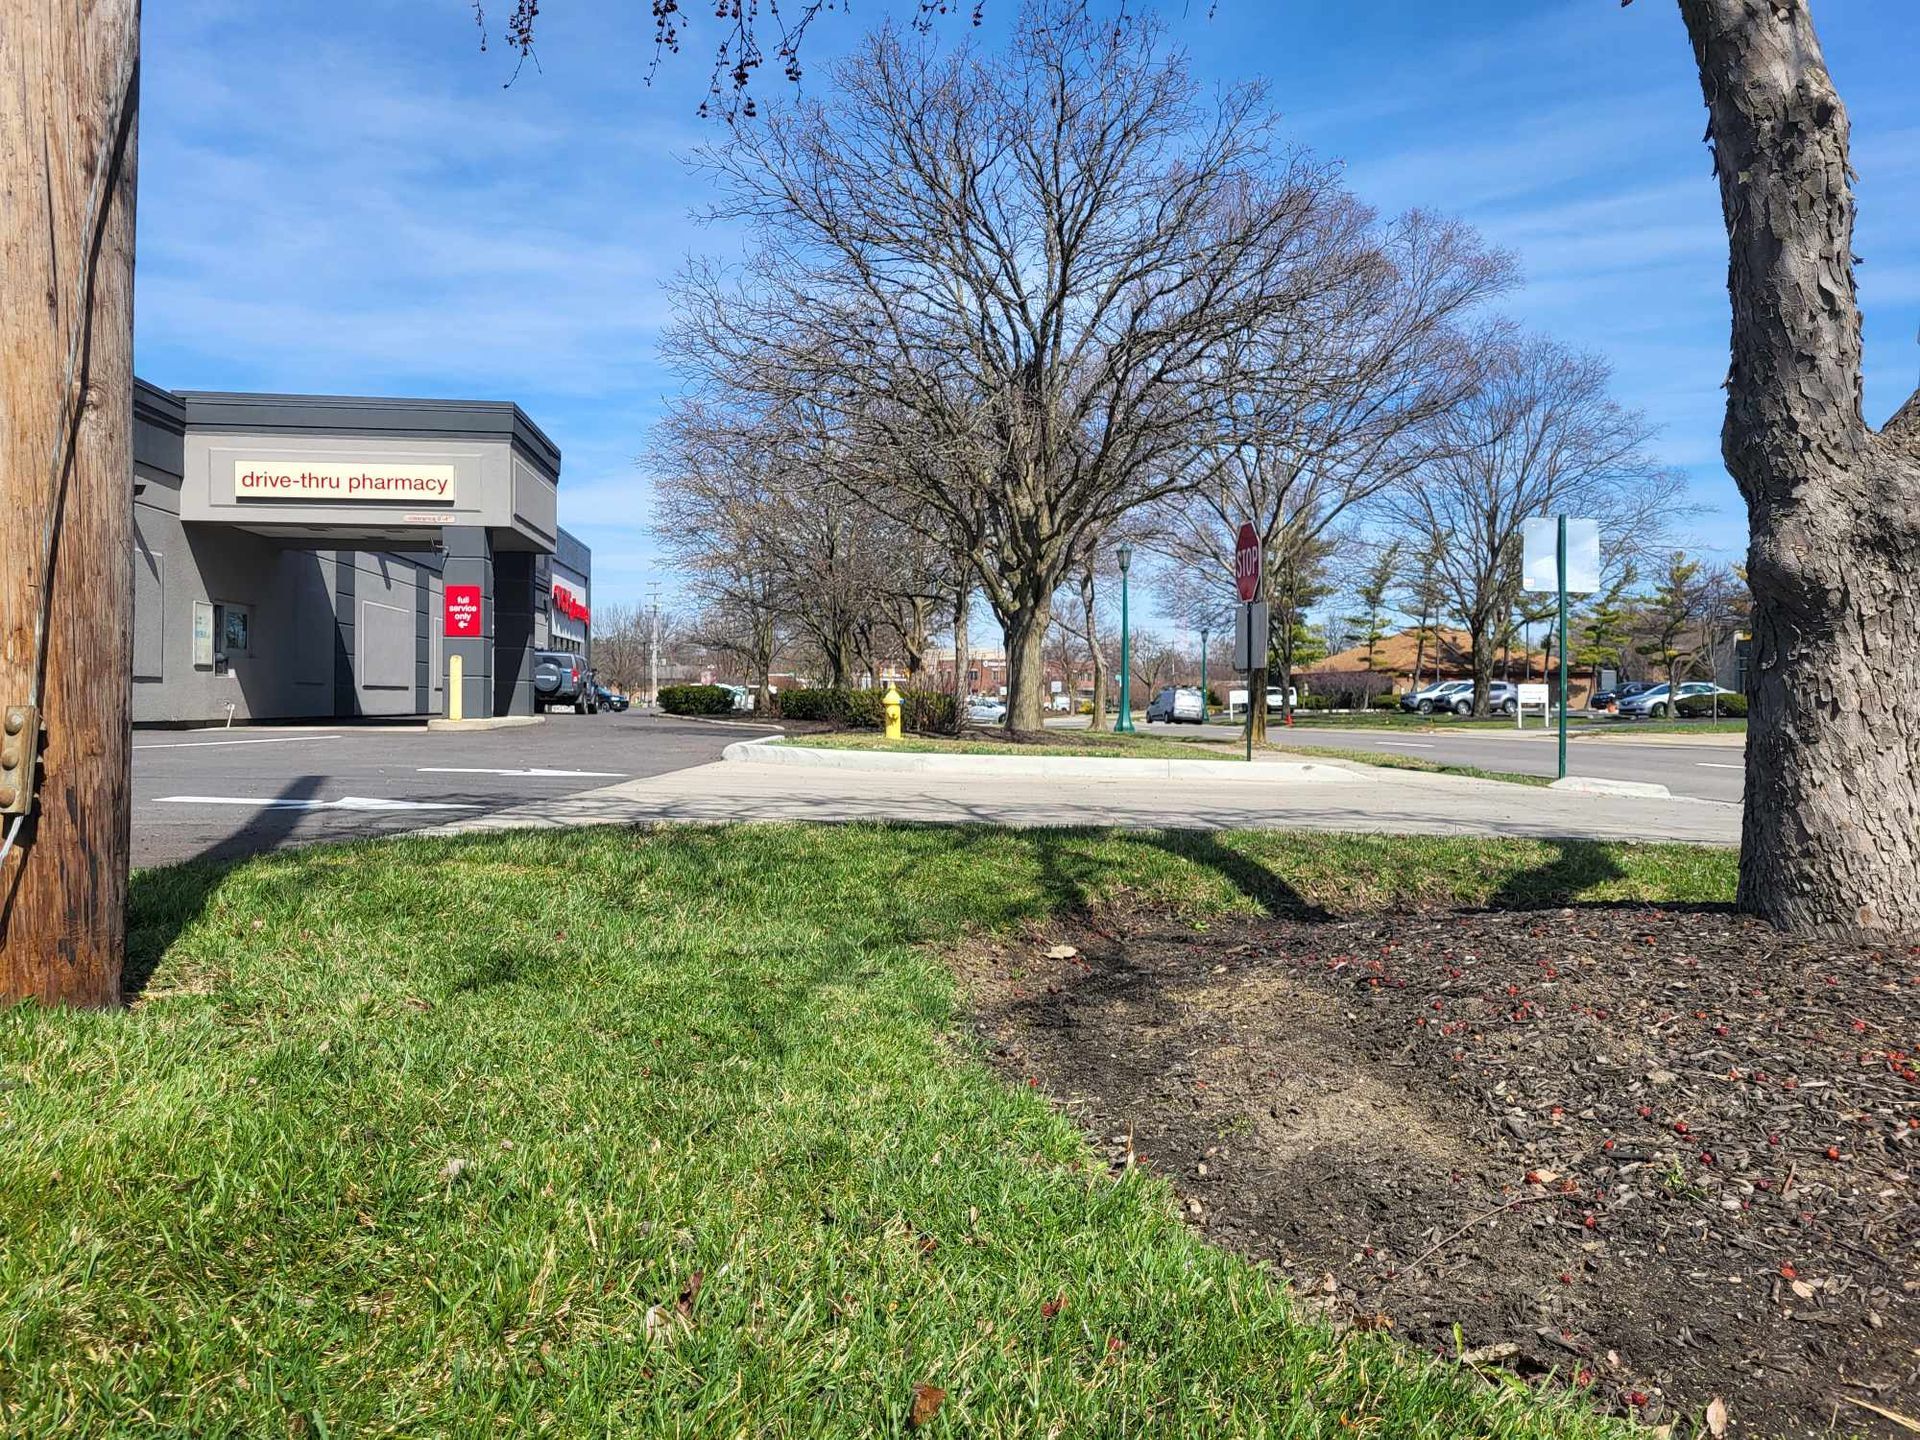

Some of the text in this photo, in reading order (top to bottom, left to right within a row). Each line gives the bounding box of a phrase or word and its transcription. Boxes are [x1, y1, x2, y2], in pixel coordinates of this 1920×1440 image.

[241, 471, 448, 495] drive-thru pharmacy
[1236, 545, 1258, 578] STOP
[457, 596, 470, 604] full
[454, 613, 471, 621] only
